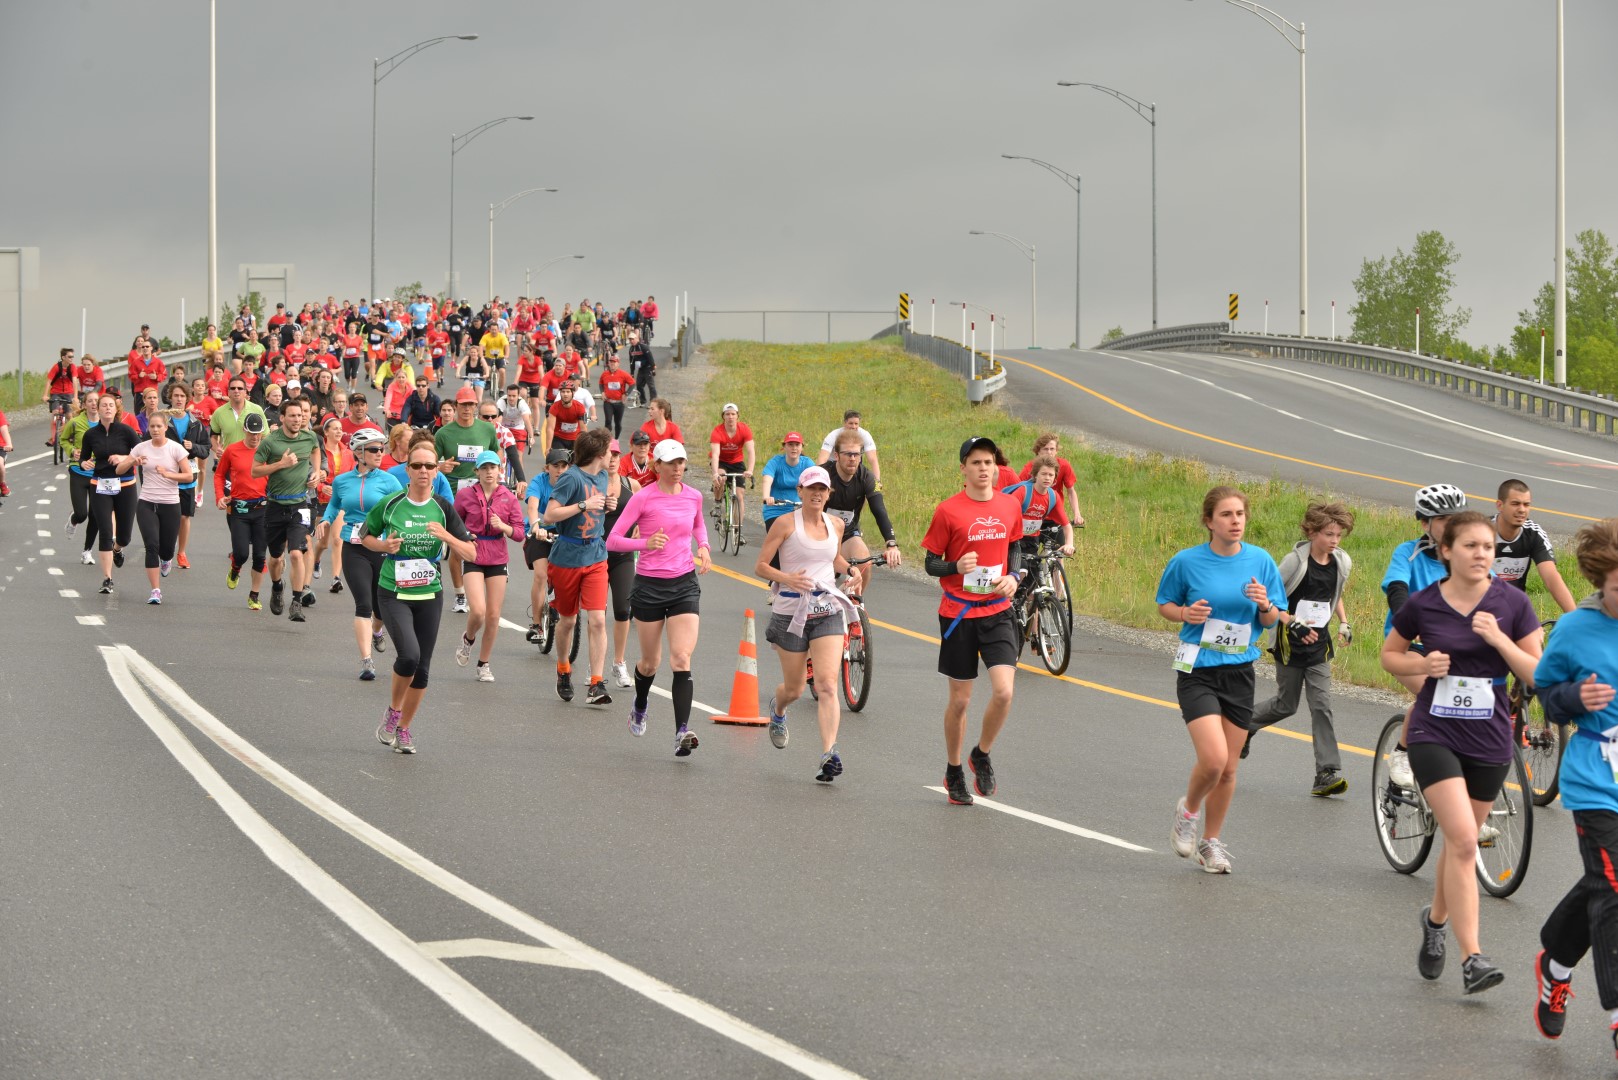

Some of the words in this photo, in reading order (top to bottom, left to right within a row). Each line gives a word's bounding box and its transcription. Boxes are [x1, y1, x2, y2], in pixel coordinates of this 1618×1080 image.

[968, 532, 1007, 541] SAINT-HILAIRE
[411, 570, 435, 580] 0025
[1215, 635, 1238, 646] 241
[1453, 695, 1472, 708] 96
